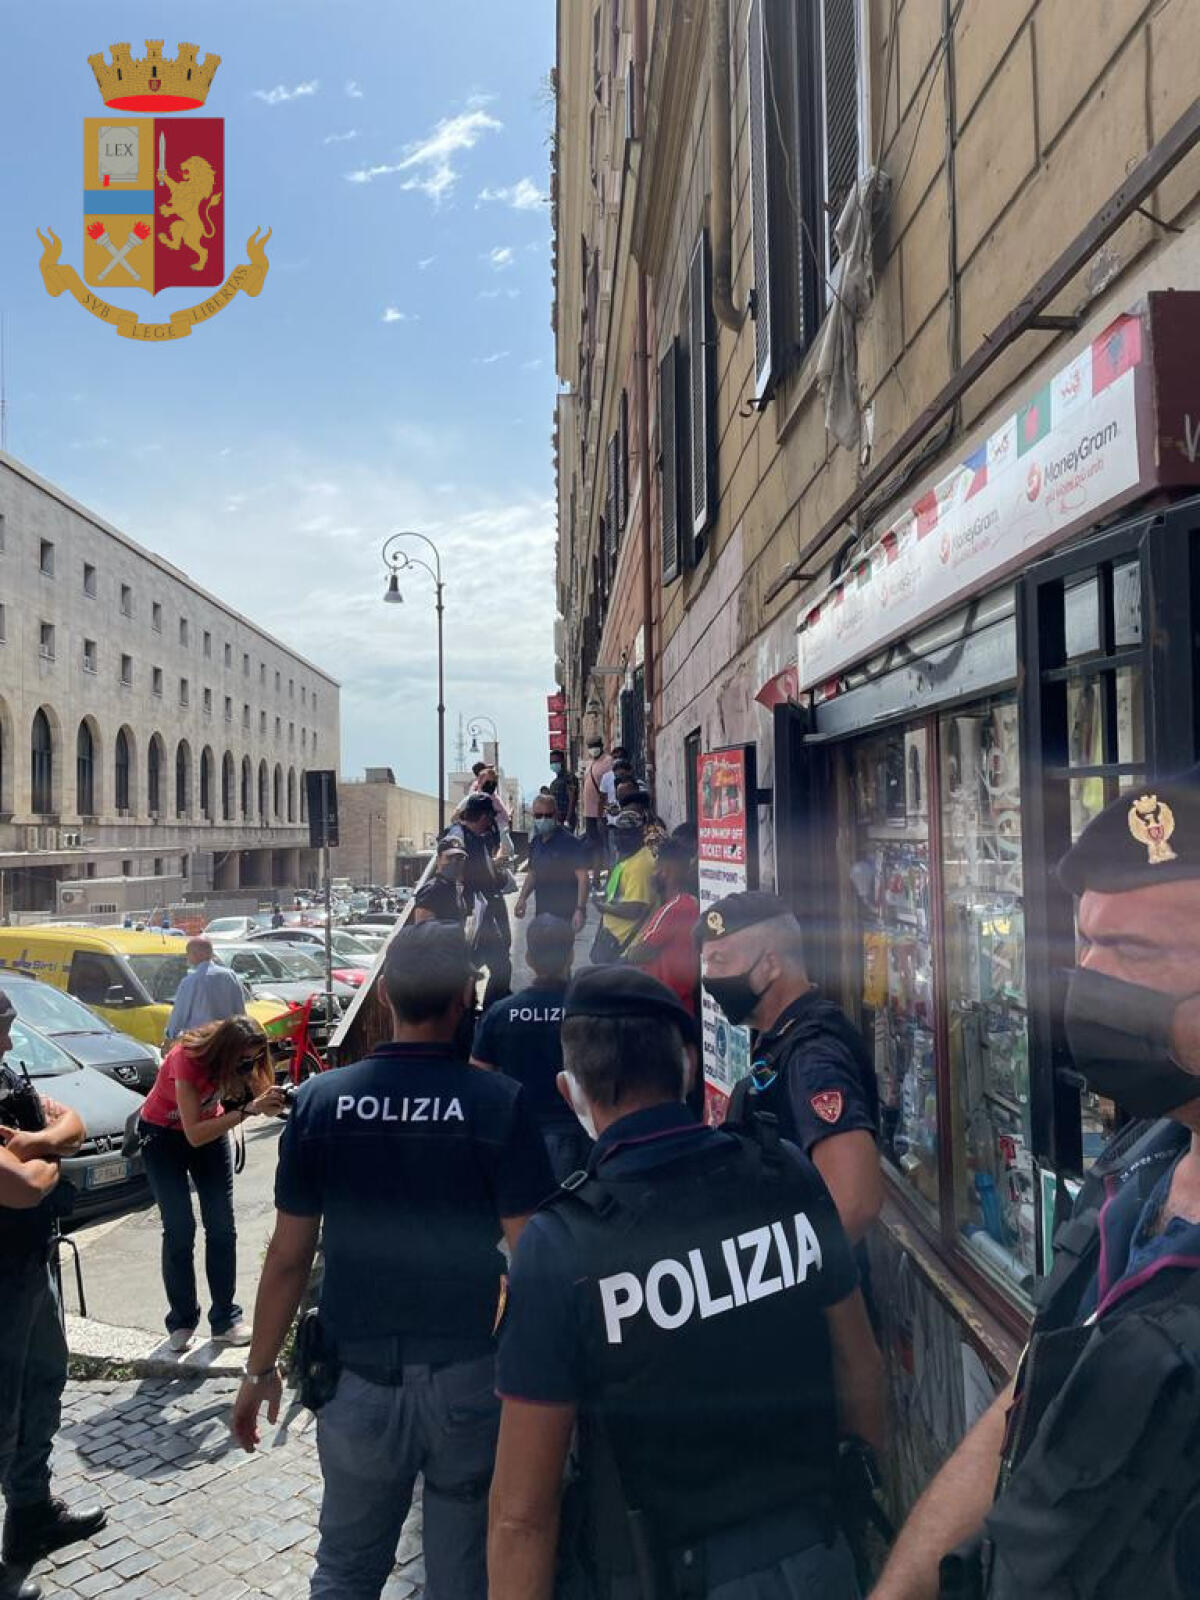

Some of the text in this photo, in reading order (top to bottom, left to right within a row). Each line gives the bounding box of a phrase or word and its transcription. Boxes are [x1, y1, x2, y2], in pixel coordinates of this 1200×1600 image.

[1043, 420, 1118, 488] MoneyGram
[509, 1007, 566, 1022] POLIZI
[336, 1095, 465, 1121] POLIZIA
[598, 1212, 823, 1344] POLIZIA
